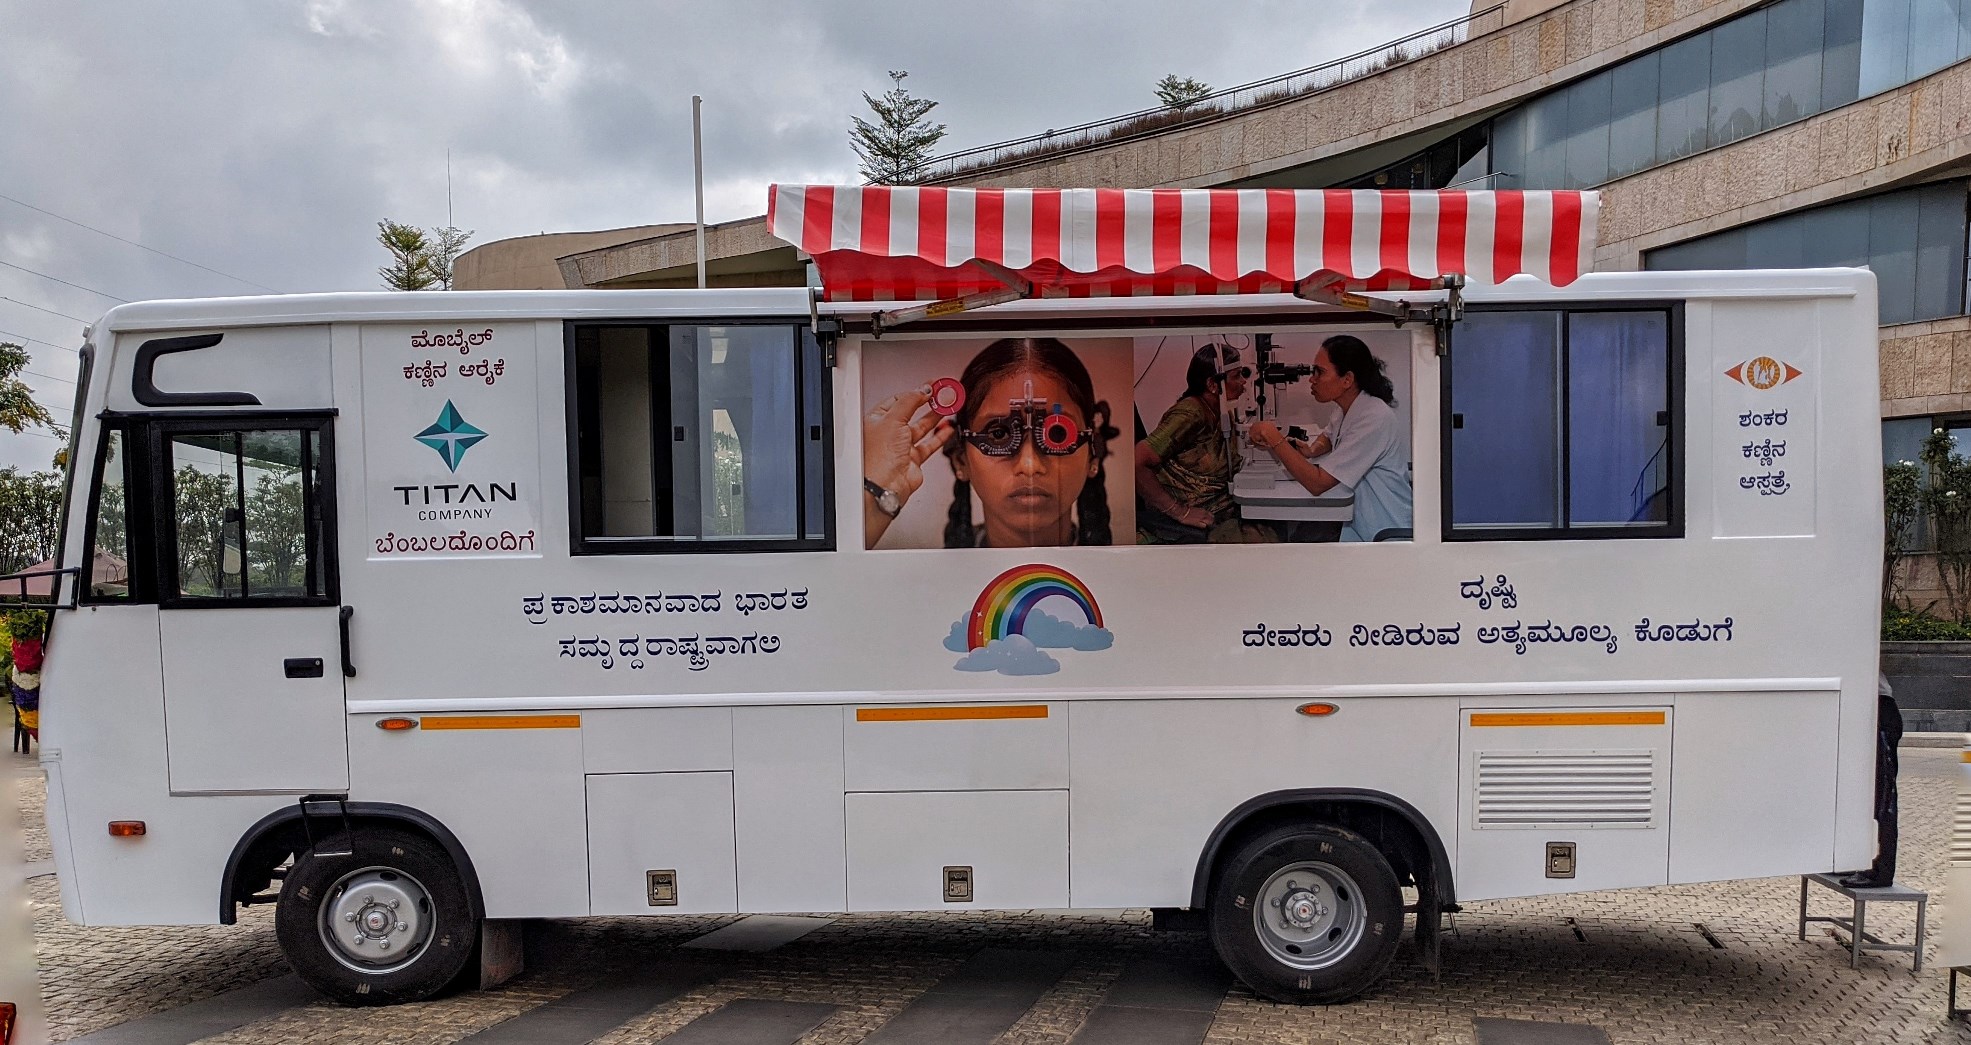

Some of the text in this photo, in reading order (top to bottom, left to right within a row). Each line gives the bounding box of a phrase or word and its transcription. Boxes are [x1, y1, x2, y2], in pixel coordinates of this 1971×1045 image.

[410, 329, 493, 355] ಮೊಬೈಲ್
[403, 359, 504, 387] ಕಣ್ಣಿನ ಆರೈಕೆ
[1739, 409, 1788, 427] ಶಂಕರ
[1742, 439, 1786, 466] ಕಣ್ಣಿನ
[394, 482, 516, 505] TITAN
[419, 509, 491, 521] COMPANY
[376, 530, 534, 553] ಬೆಂಬಲದೊಂದಿಗೆ
[523, 587, 808, 624] ಪ್ರಕಾಶಮಾನವಾದ ಭಾರತ
[1243, 623, 1331, 646] ದೇವರು
[1349, 622, 1460, 647] ನೀಡಿರುವ
[1635, 617, 1733, 641] ಕೊಡುಗೆ
